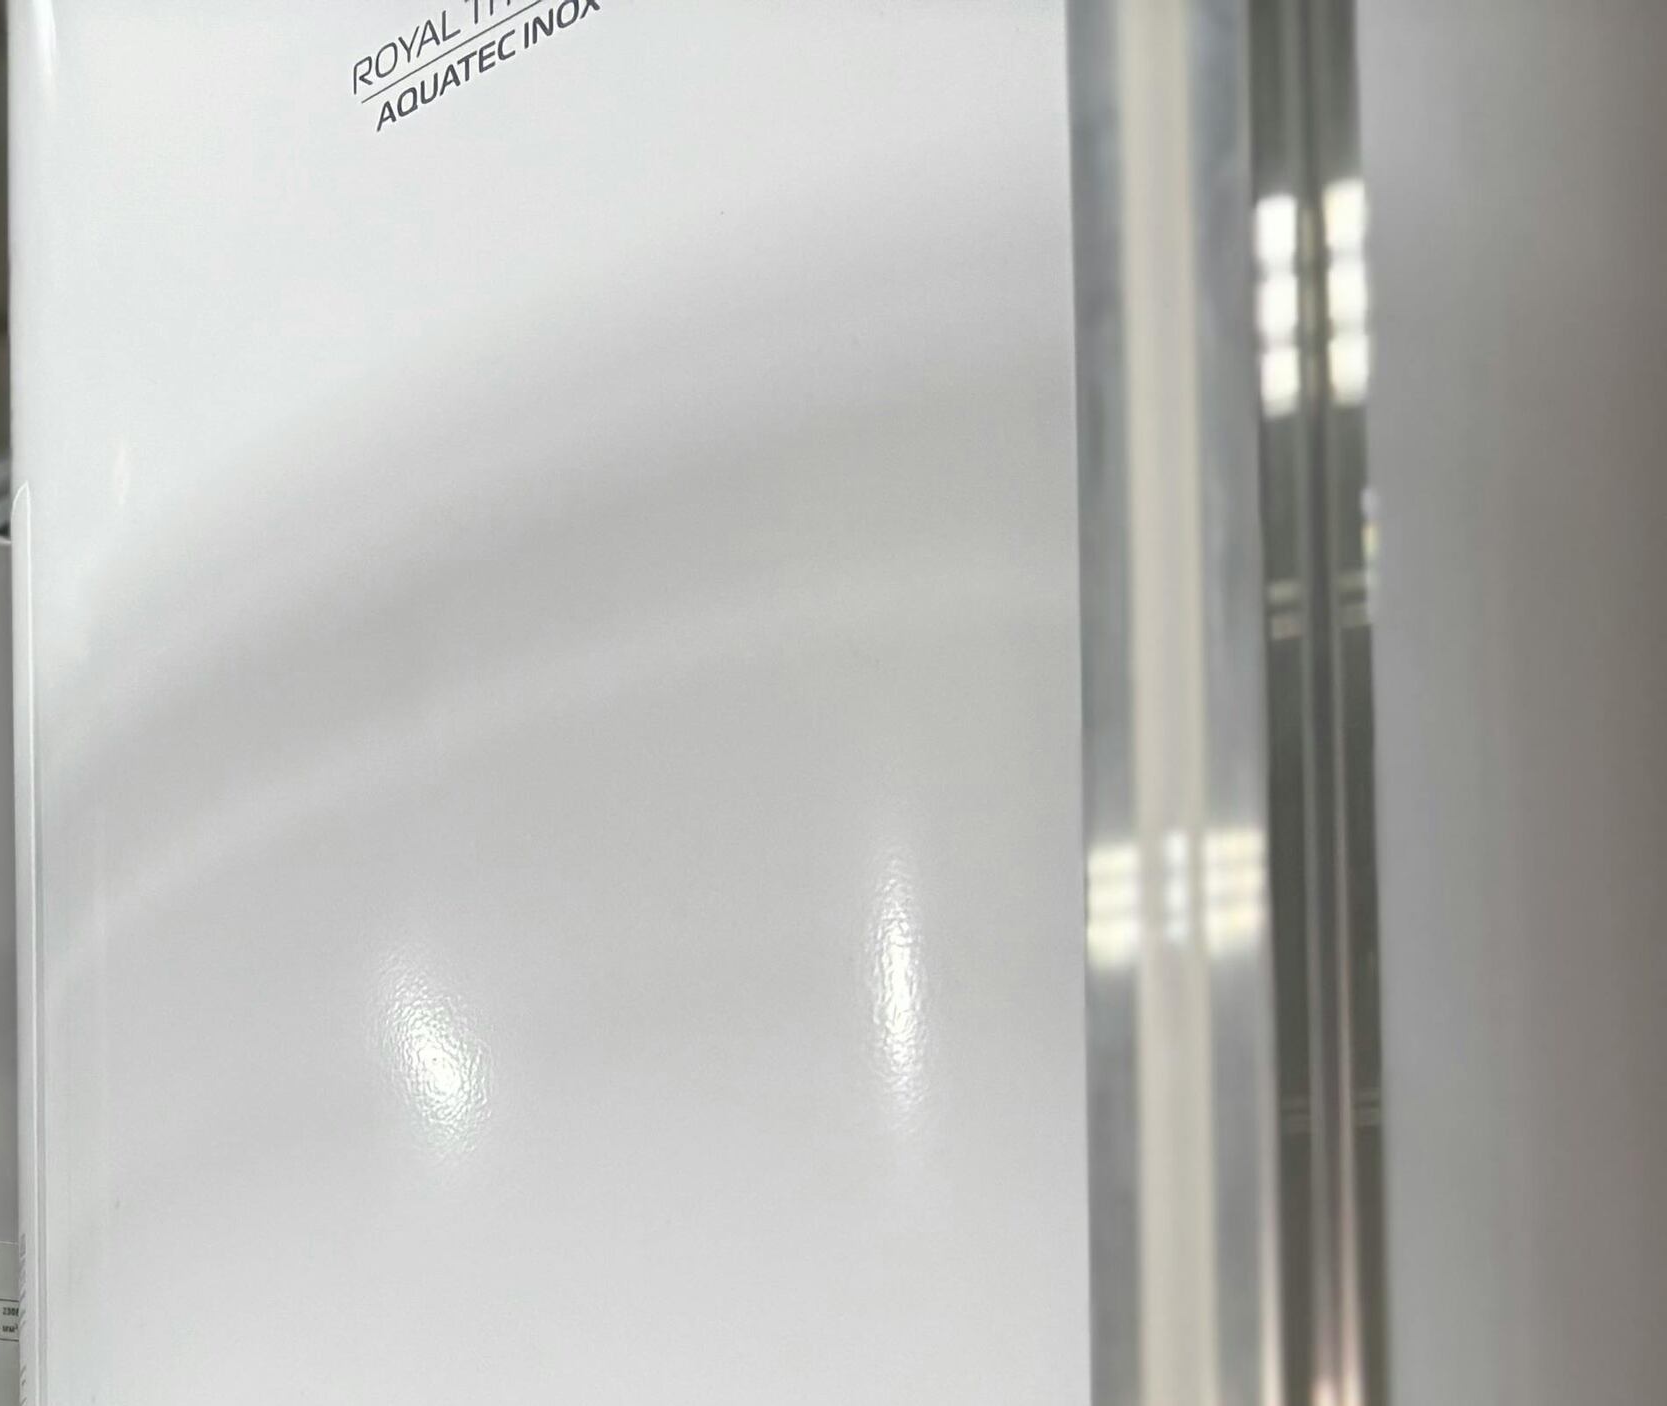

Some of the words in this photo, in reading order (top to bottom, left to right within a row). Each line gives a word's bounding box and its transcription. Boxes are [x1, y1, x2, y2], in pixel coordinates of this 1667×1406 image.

[352, 10, 462, 96] ROYAL
[375, 29, 517, 133] AQUATEC
[522, 0, 602, 50] INOX
